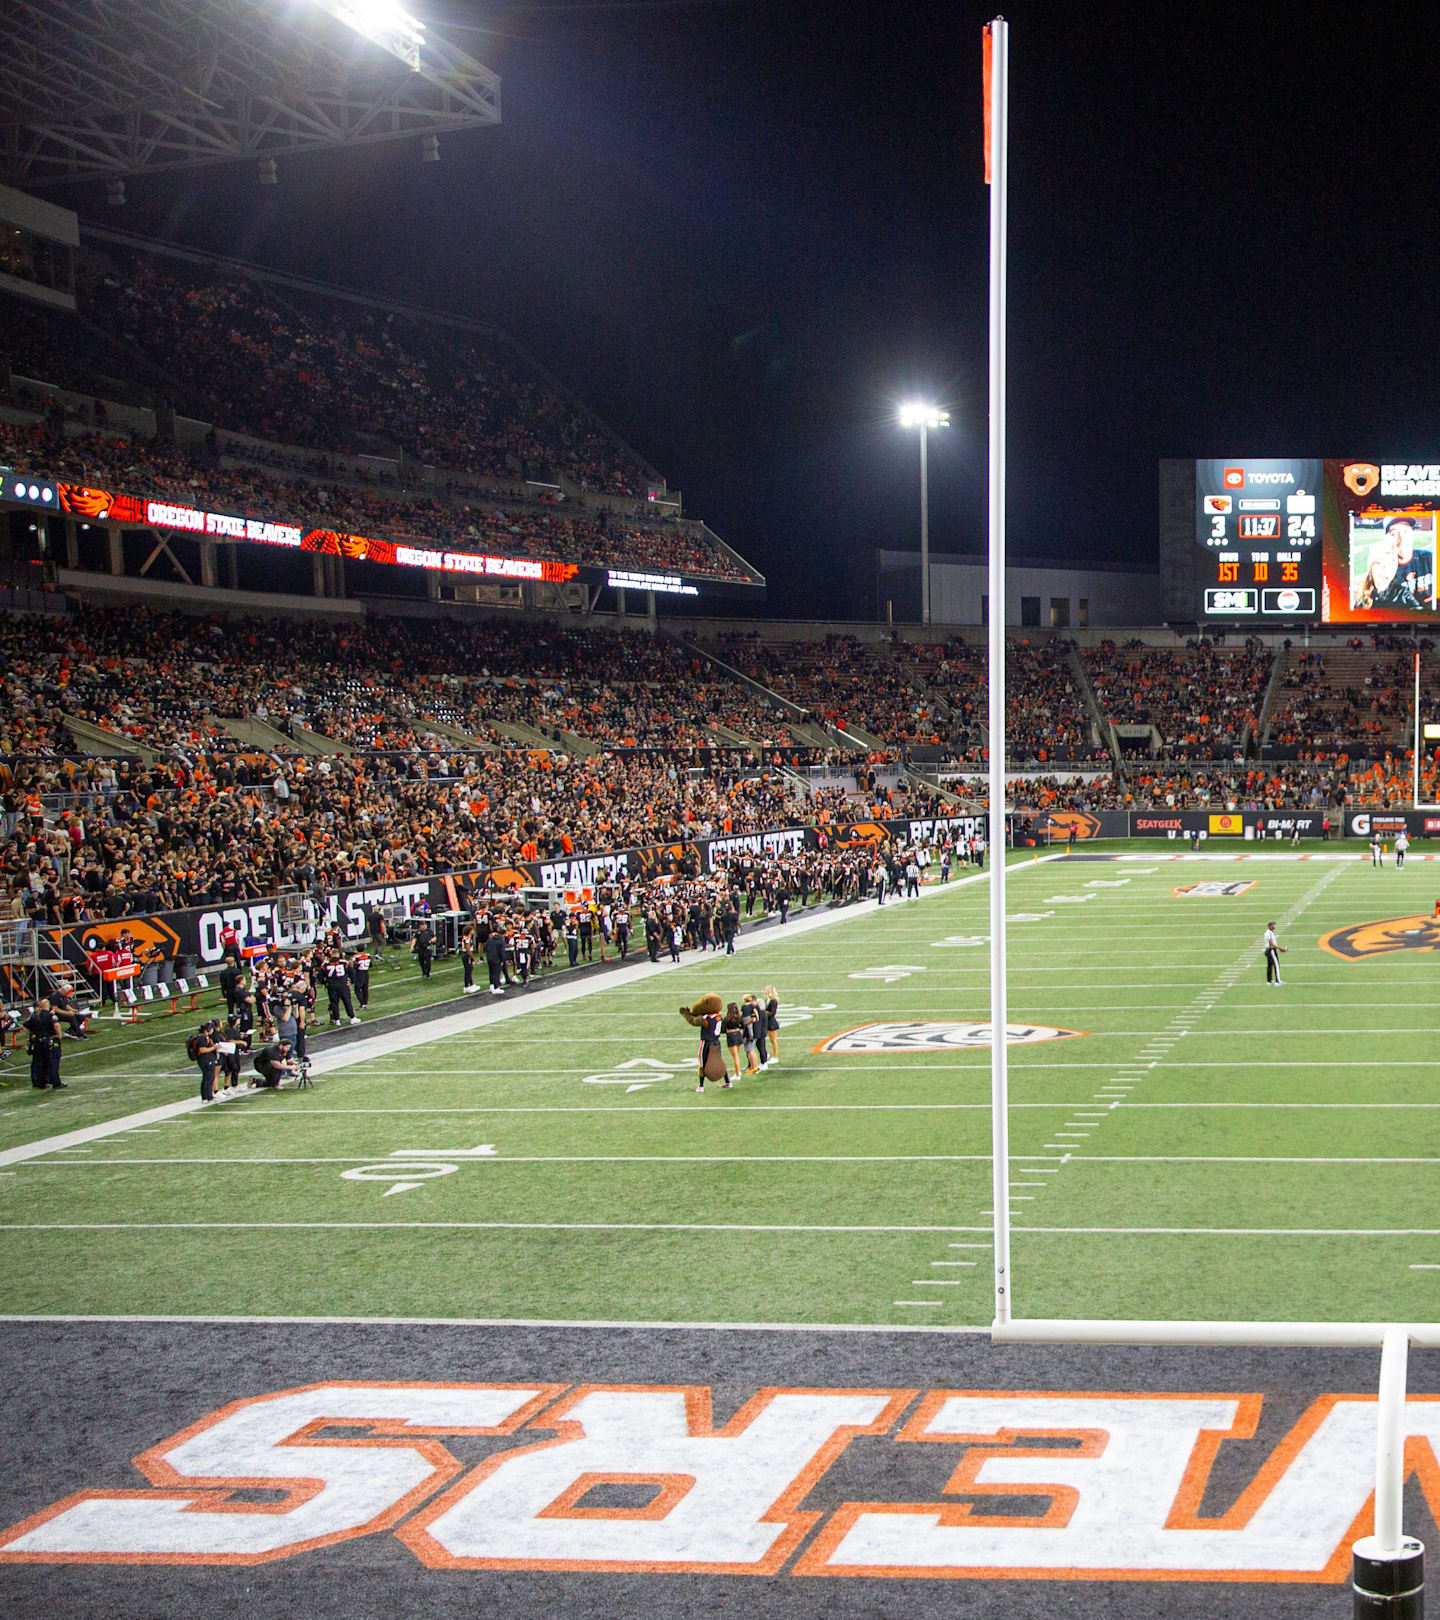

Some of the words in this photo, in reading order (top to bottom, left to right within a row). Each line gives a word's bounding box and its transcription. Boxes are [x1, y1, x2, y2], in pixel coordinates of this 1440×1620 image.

[1248, 472, 1295, 483] TOYOTA
[148, 502, 205, 530] OREGON
[206, 513, 245, 537] STATE
[246, 520, 302, 546] BEAVERS
[1211, 516, 1225, 537] 3
[1244, 517, 1276, 536] 11:37
[1288, 516, 1315, 537] 24
[396, 547, 441, 568] OREGON
[443, 553, 484, 572] STATE
[485, 558, 542, 578] BEAVERS
[1218, 562, 1240, 582] 1ST
[1253, 562, 1268, 582] 10
[1281, 562, 1298, 582] 35
[910, 817, 984, 847] BEAVERS
[1136, 819, 1183, 829] SEATGEEK
[541, 855, 628, 888] BEAVERS
[326, 964, 346, 977] 79
[582, 1058, 700, 1084] 20
[340, 1143, 498, 1181] 10
